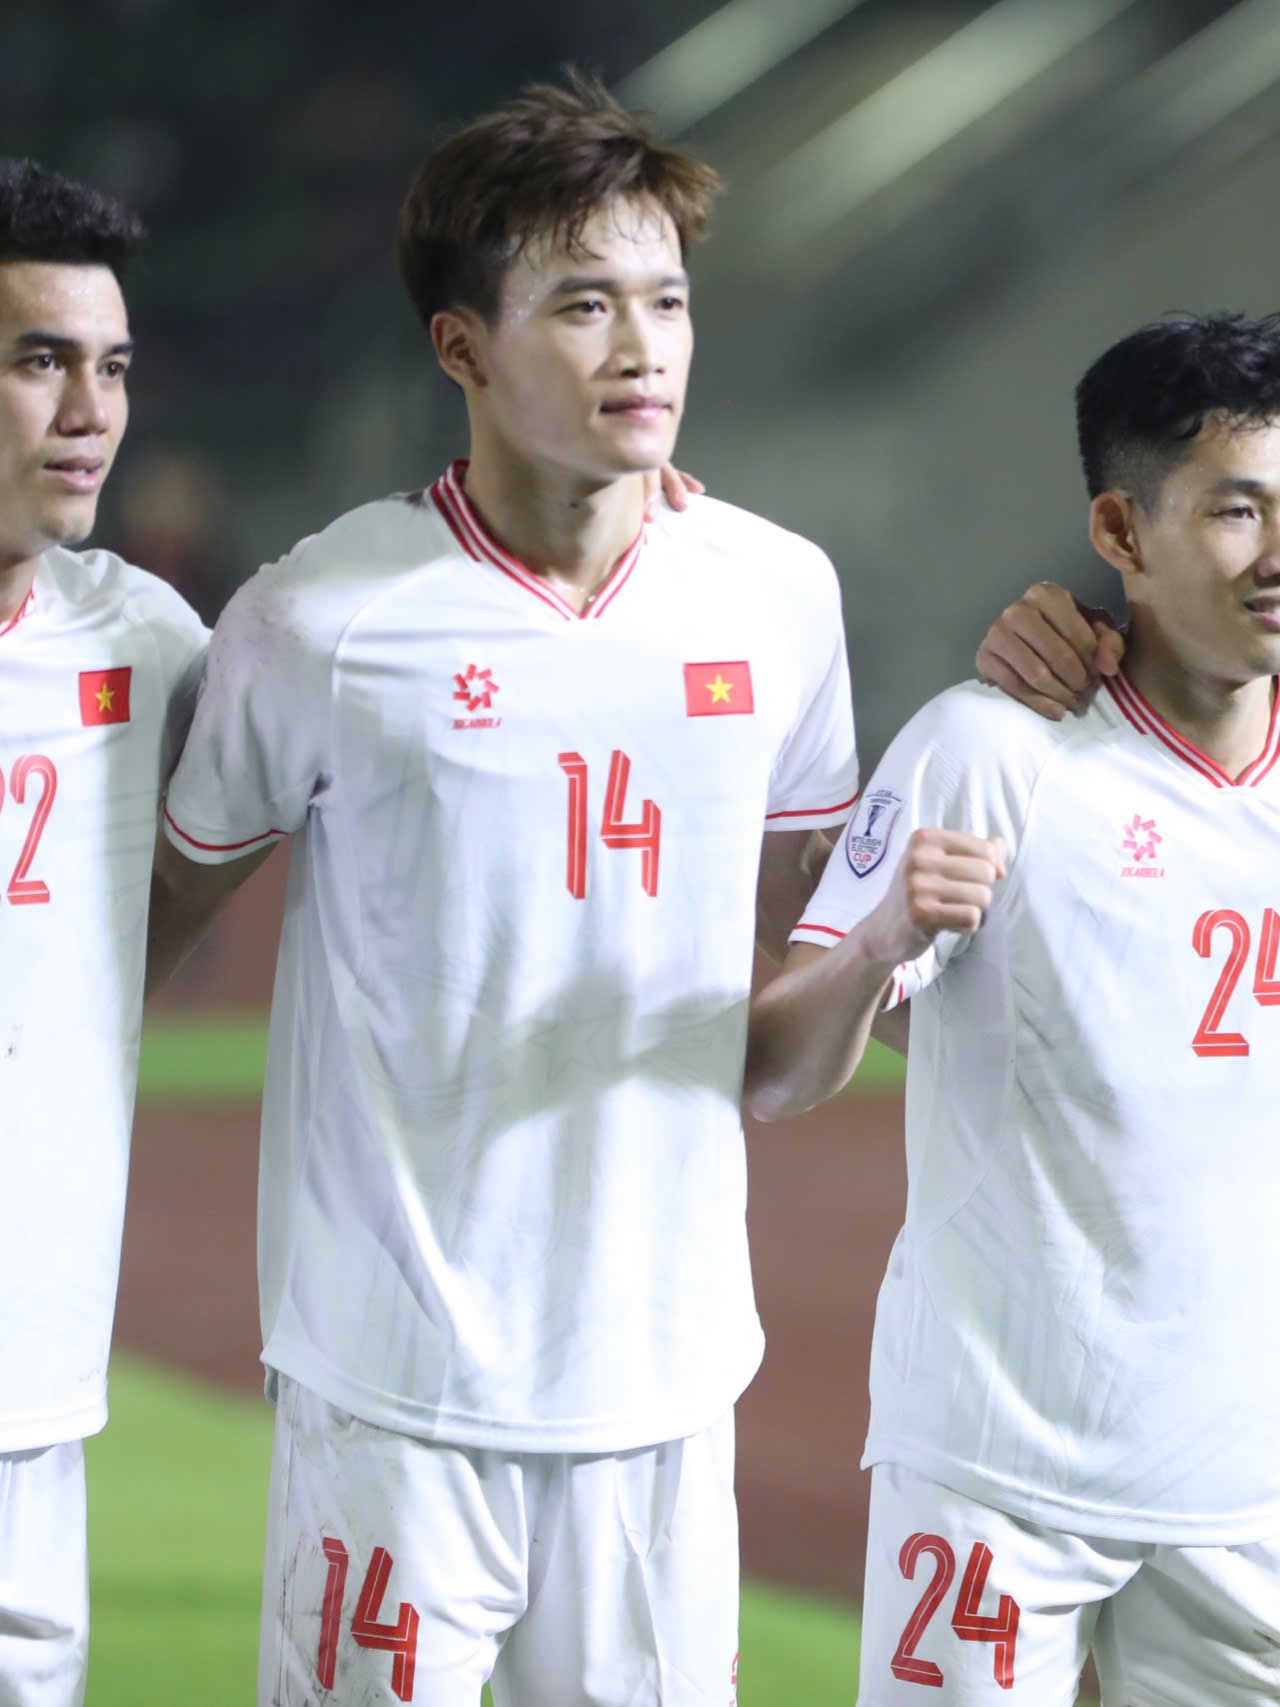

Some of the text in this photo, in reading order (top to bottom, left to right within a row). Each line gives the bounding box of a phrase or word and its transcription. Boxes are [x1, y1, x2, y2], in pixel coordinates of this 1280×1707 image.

[0, 756, 57, 905] 2
[558, 749, 661, 899] 14
[853, 853, 872, 863] CUP
[317, 1537, 420, 1702] 14
[891, 1532, 1020, 1689] 24
